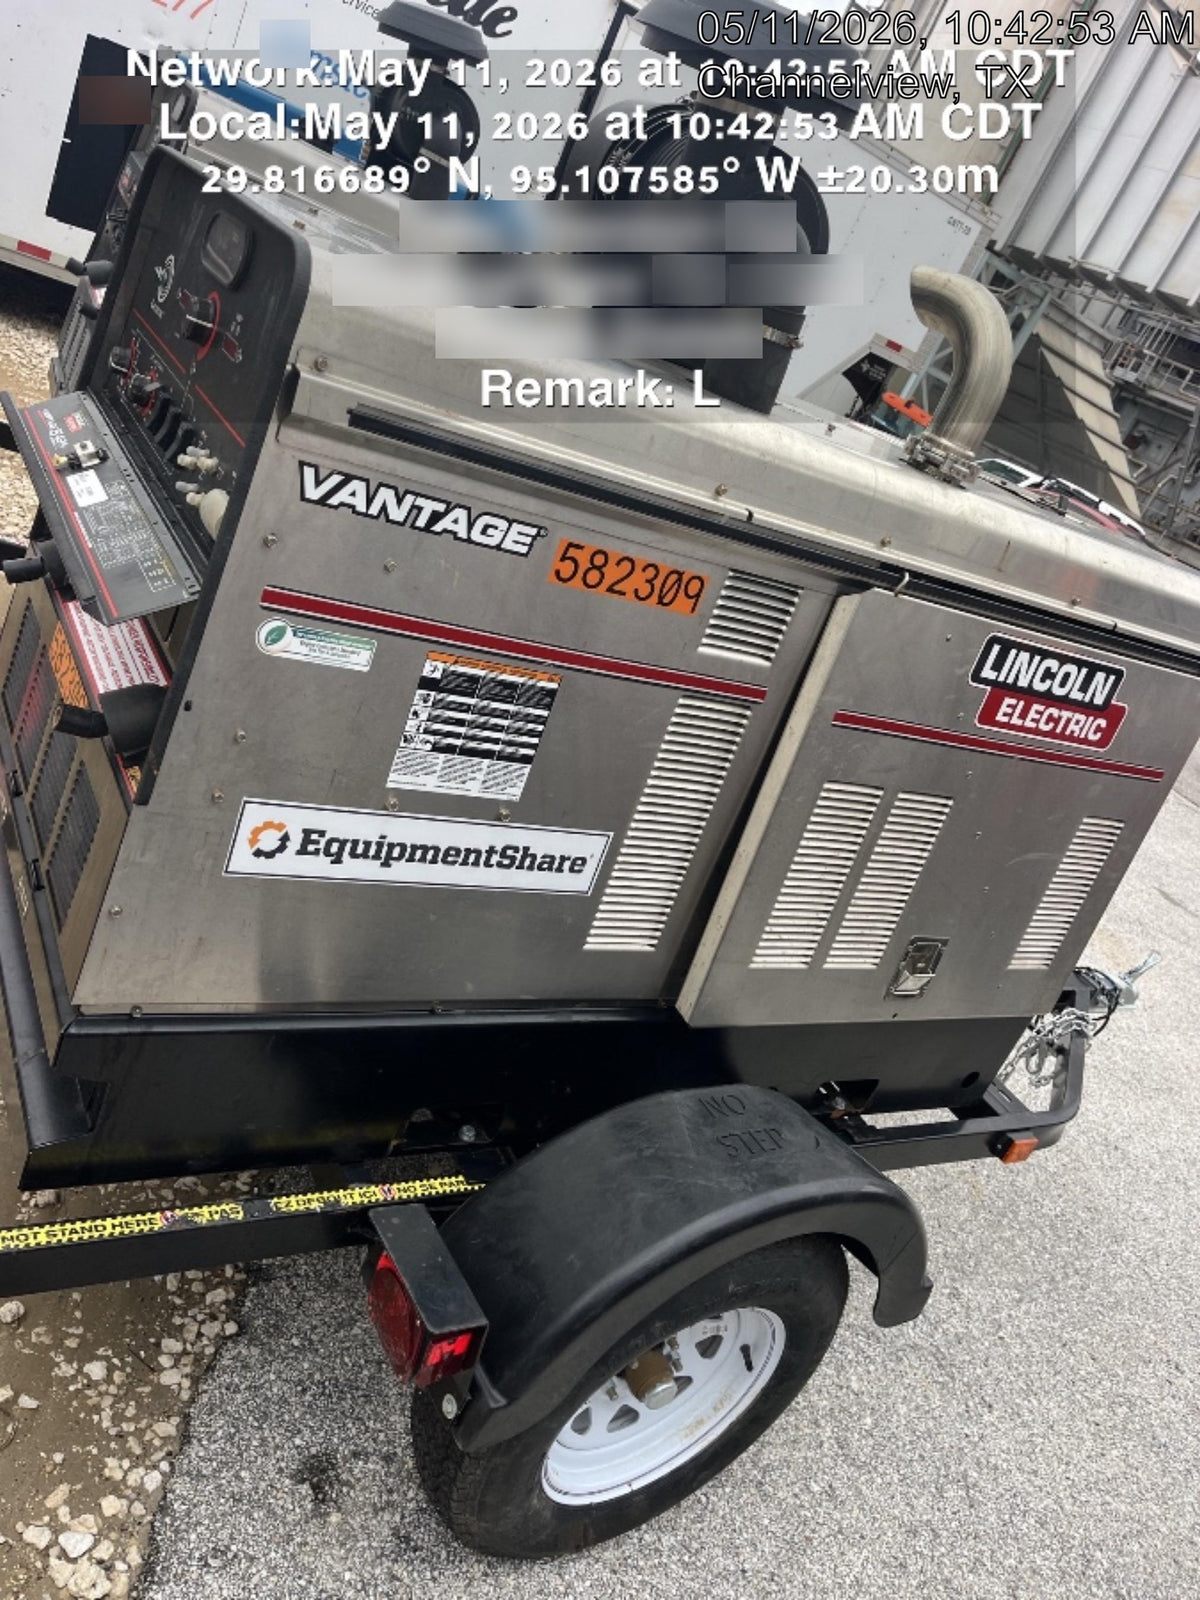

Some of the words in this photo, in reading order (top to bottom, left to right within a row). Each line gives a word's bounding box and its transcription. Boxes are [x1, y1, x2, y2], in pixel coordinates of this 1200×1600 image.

[300, 463, 540, 557] VANTAGE
[554, 542, 706, 614] 582309
[980, 643, 1116, 706] LINCOLN
[995, 697, 1108, 741] ELECTRIC
[295, 827, 588, 874] EquipmentShare
[697, 1094, 746, 1119] NO
[716, 1128, 784, 1158] STEP
[0, 1232, 41, 1246] NOT
[46, 1223, 108, 1240] STAND
[111, 1217, 160, 1232] HERE
